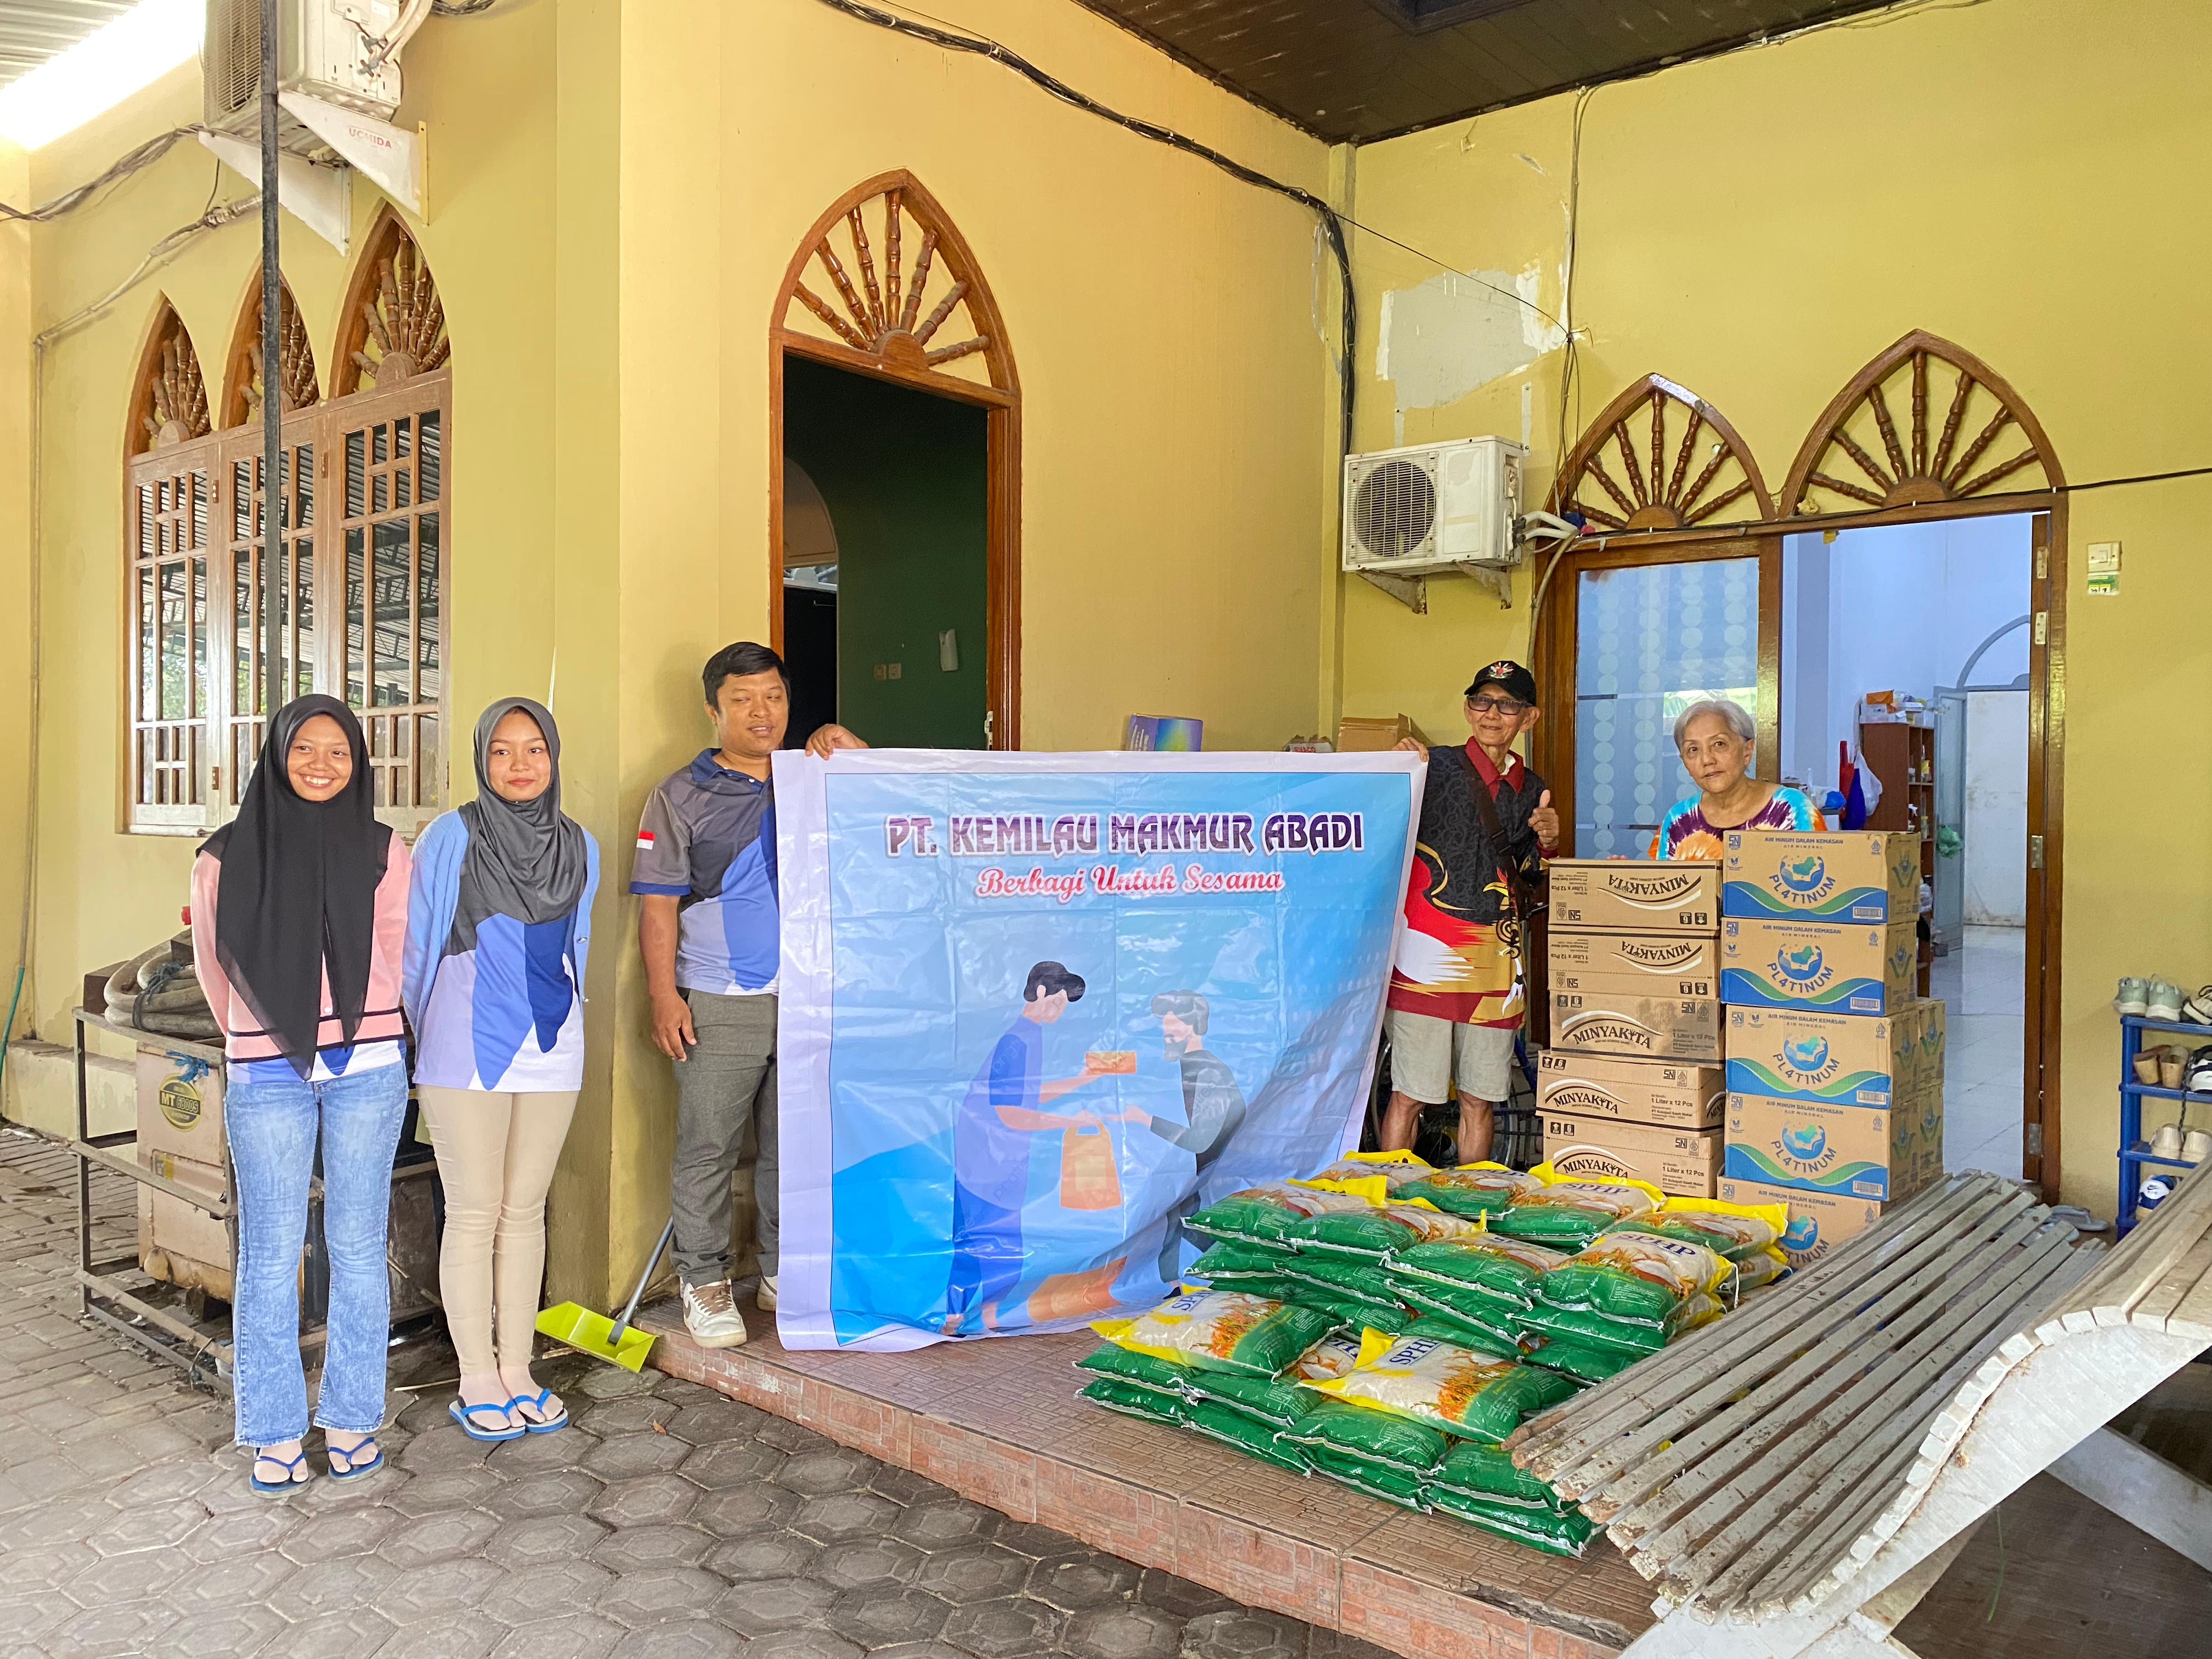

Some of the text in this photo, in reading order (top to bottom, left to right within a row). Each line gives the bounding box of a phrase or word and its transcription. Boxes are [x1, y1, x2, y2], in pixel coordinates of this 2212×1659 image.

[885, 812, 1364, 857] PT. KEMILAU MAKMUR ABADI
[977, 864, 1284, 904] Berbagi Untuk Sesama
[161, 1092, 176, 1107] MT
[1816, 1107, 1843, 1115] KEMASAN
[1563, 1183, 1629, 1194] SPHP
[1808, 1198, 1836, 1206] KEMASAN
[1619, 1234, 1696, 1255] SPHP
